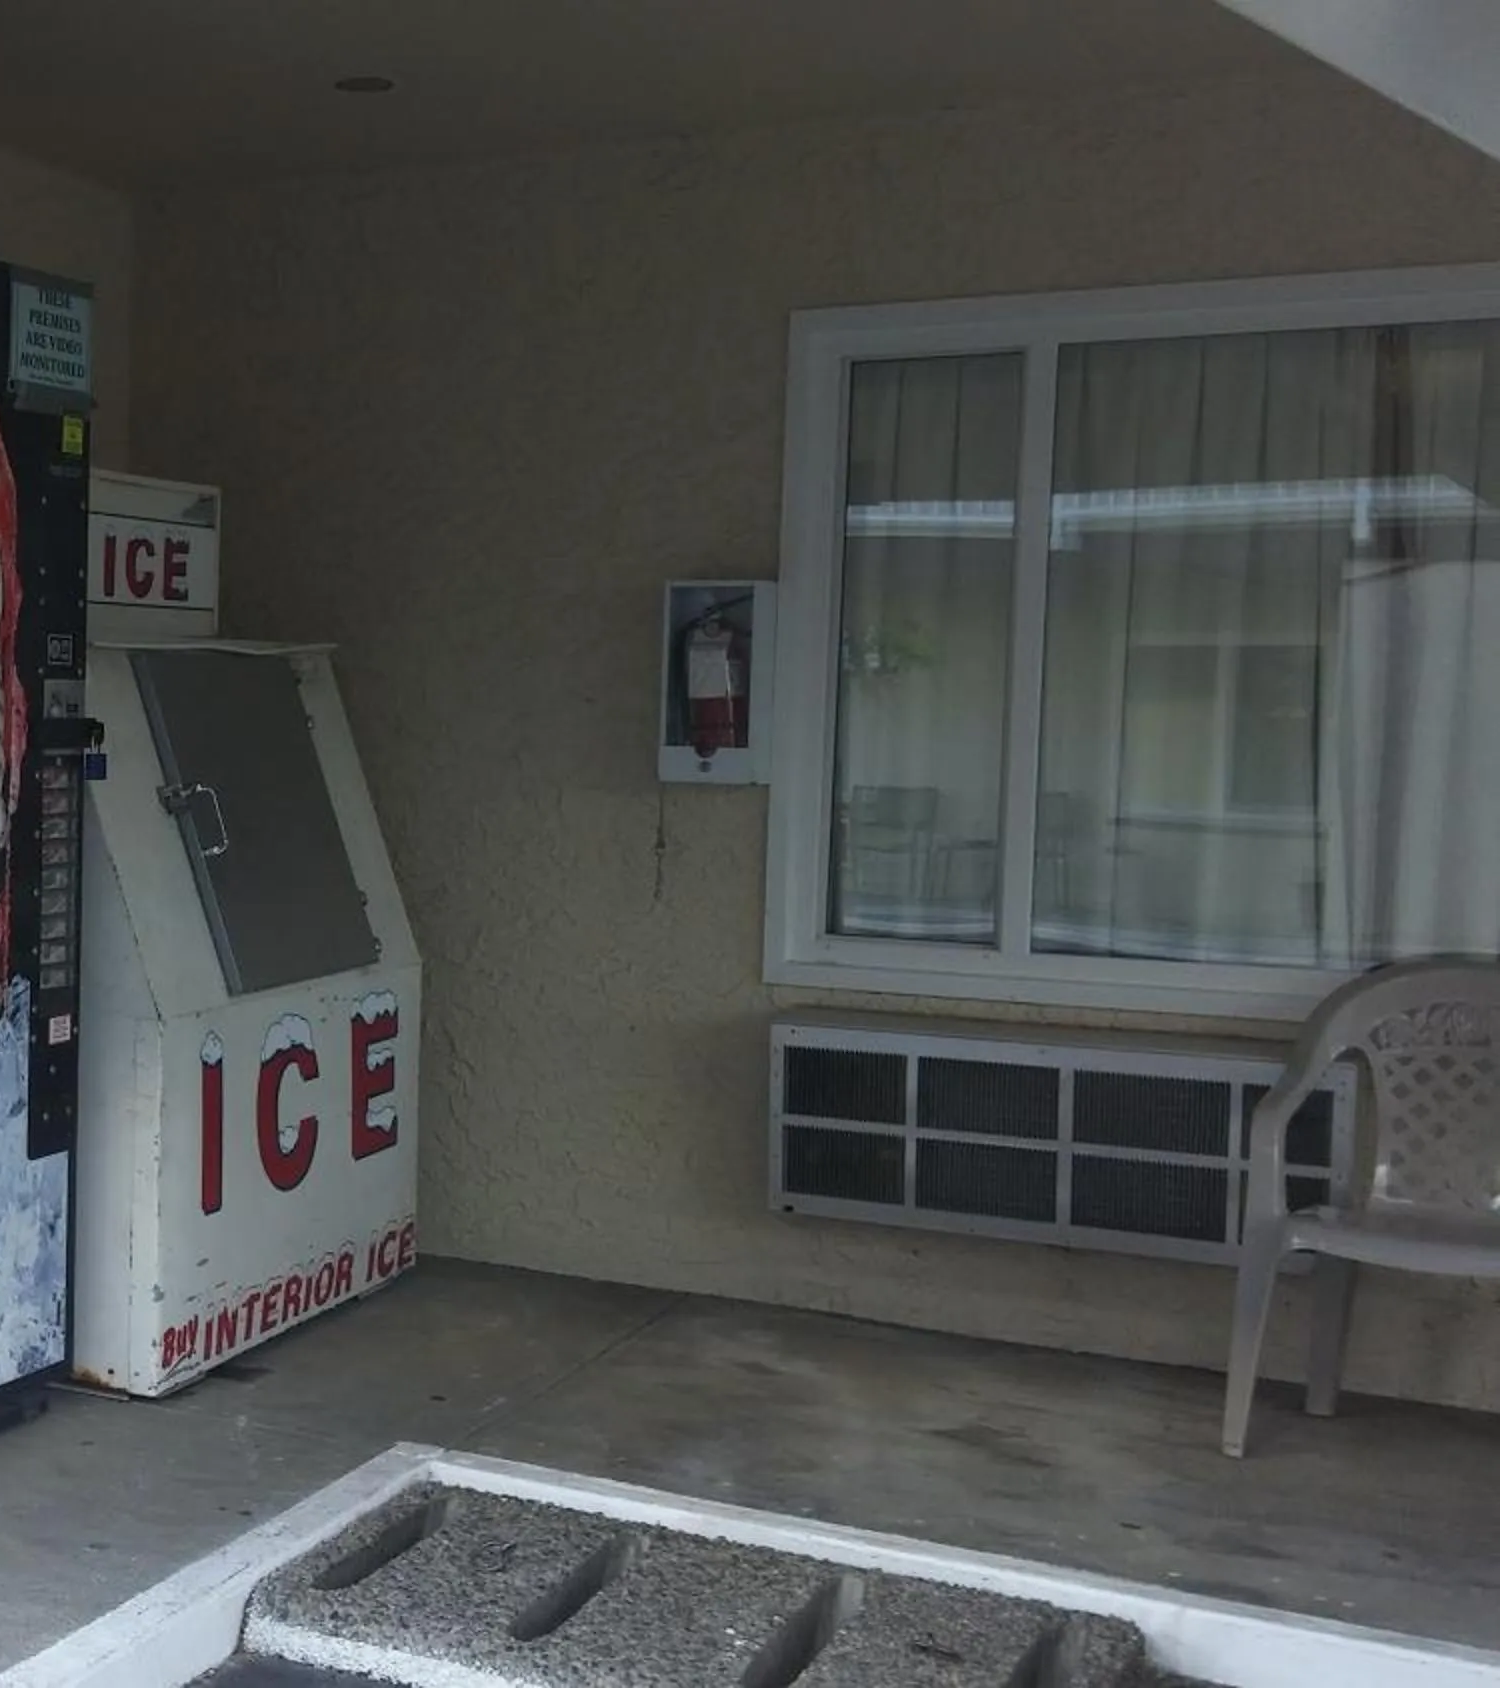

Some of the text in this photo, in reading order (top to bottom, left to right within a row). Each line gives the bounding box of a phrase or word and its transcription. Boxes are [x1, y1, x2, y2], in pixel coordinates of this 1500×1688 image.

[25, 330, 83, 355] ARE VIDEO
[29, 308, 82, 334] PREMISES
[20, 351, 85, 379] MONITORED
[102, 532, 191, 601] ICE
[200, 991, 400, 1217] ICE
[203, 1250, 355, 1361] INTERIOR
[365, 1220, 418, 1283] ICE
